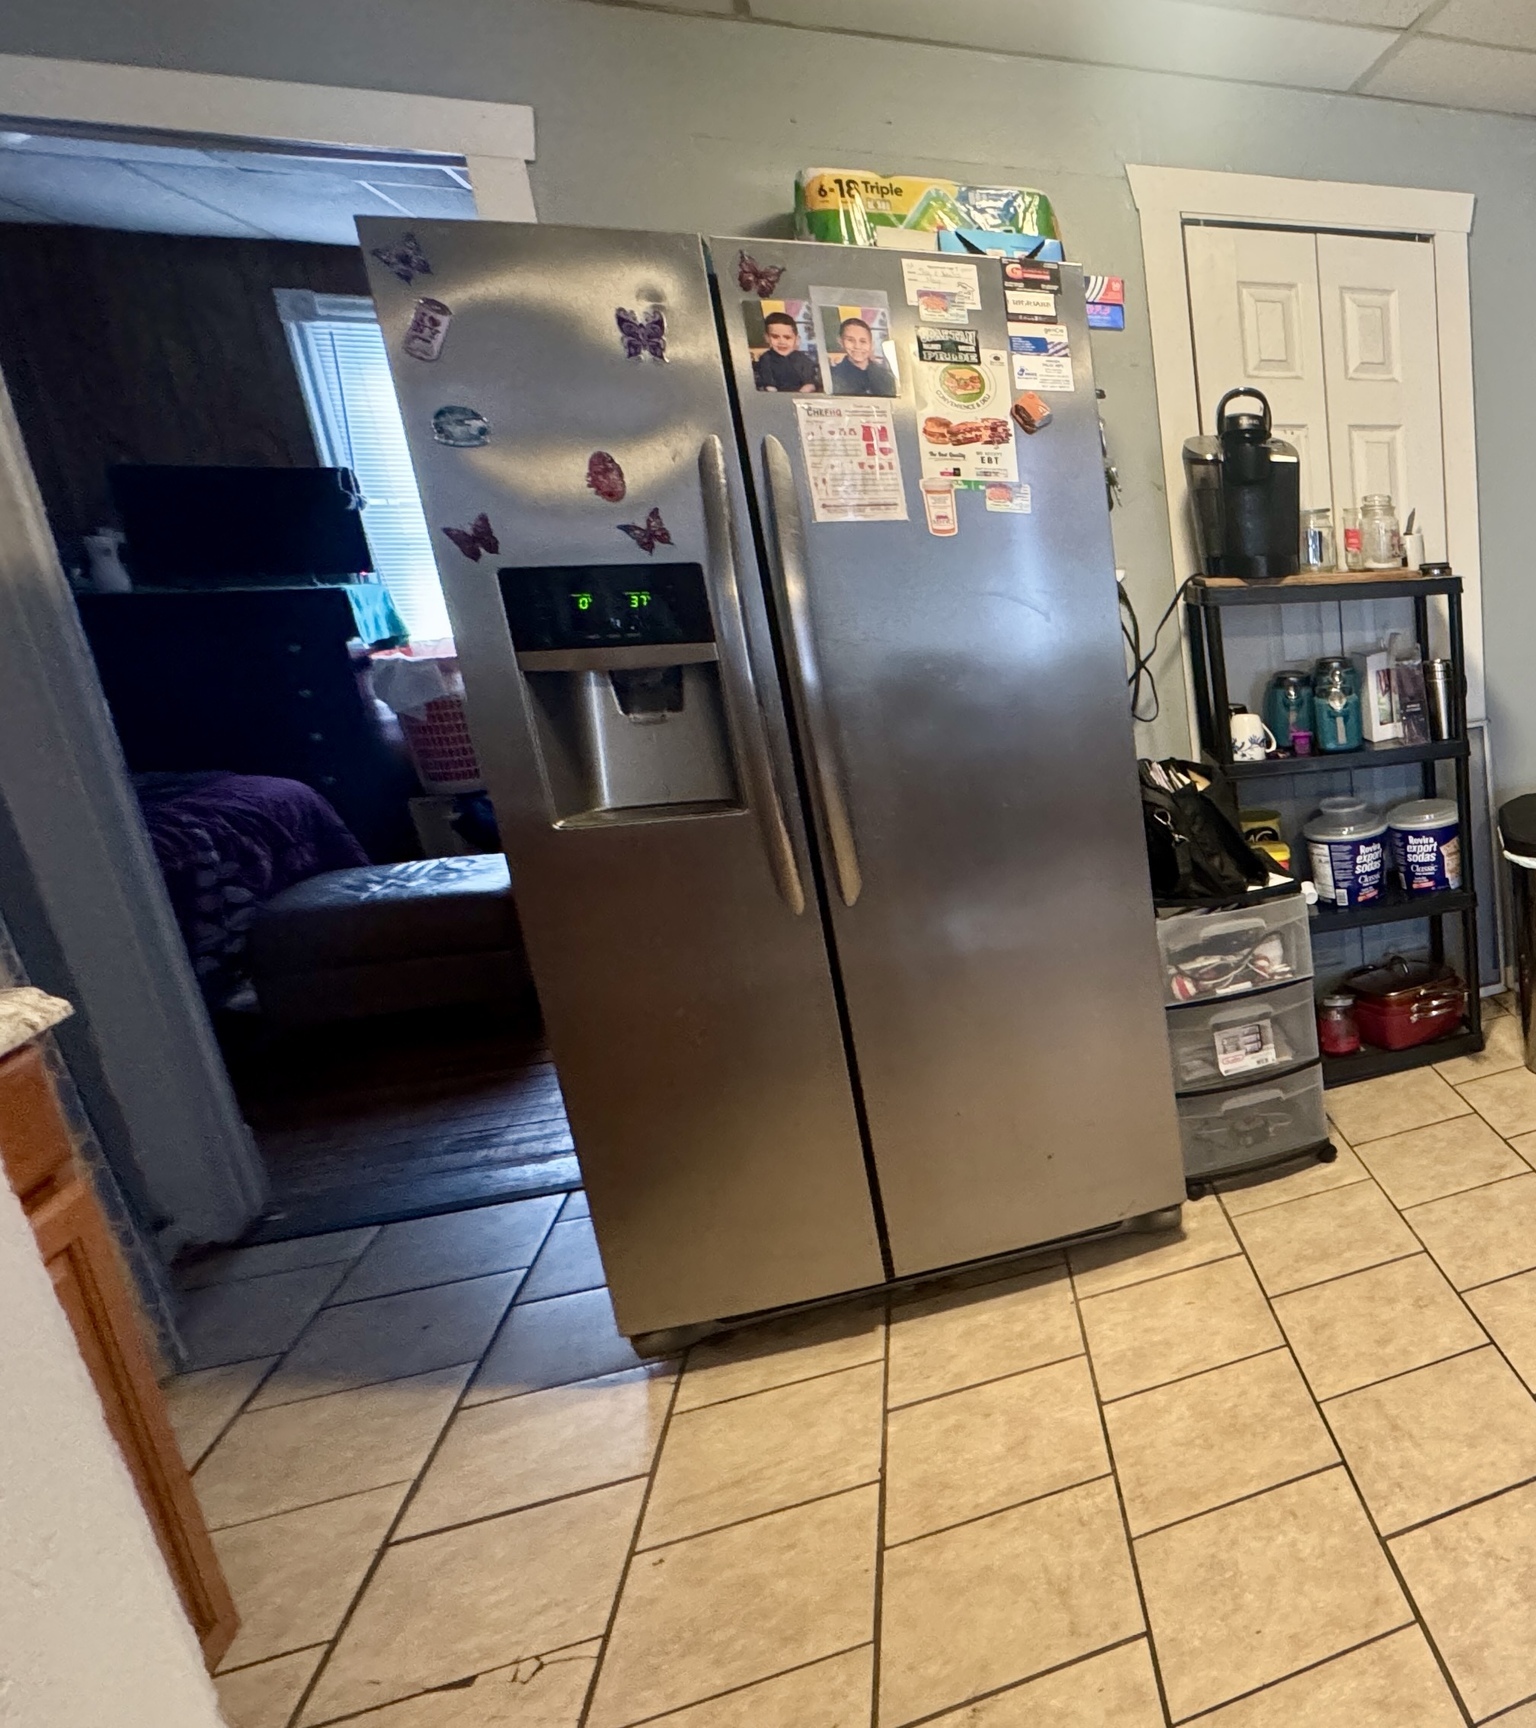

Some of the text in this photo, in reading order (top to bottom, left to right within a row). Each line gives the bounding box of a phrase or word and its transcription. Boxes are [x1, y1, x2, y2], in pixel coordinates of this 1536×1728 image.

[861, 180, 904, 199] Triple
[922, 350, 979, 363] PRIDE
[1408, 835, 1435, 846] Rovira
[1406, 841, 1438, 855] export
[1406, 852, 1437, 863] sodas
[1354, 859, 1381, 875] sodas
[1410, 863, 1439, 873] Classic
